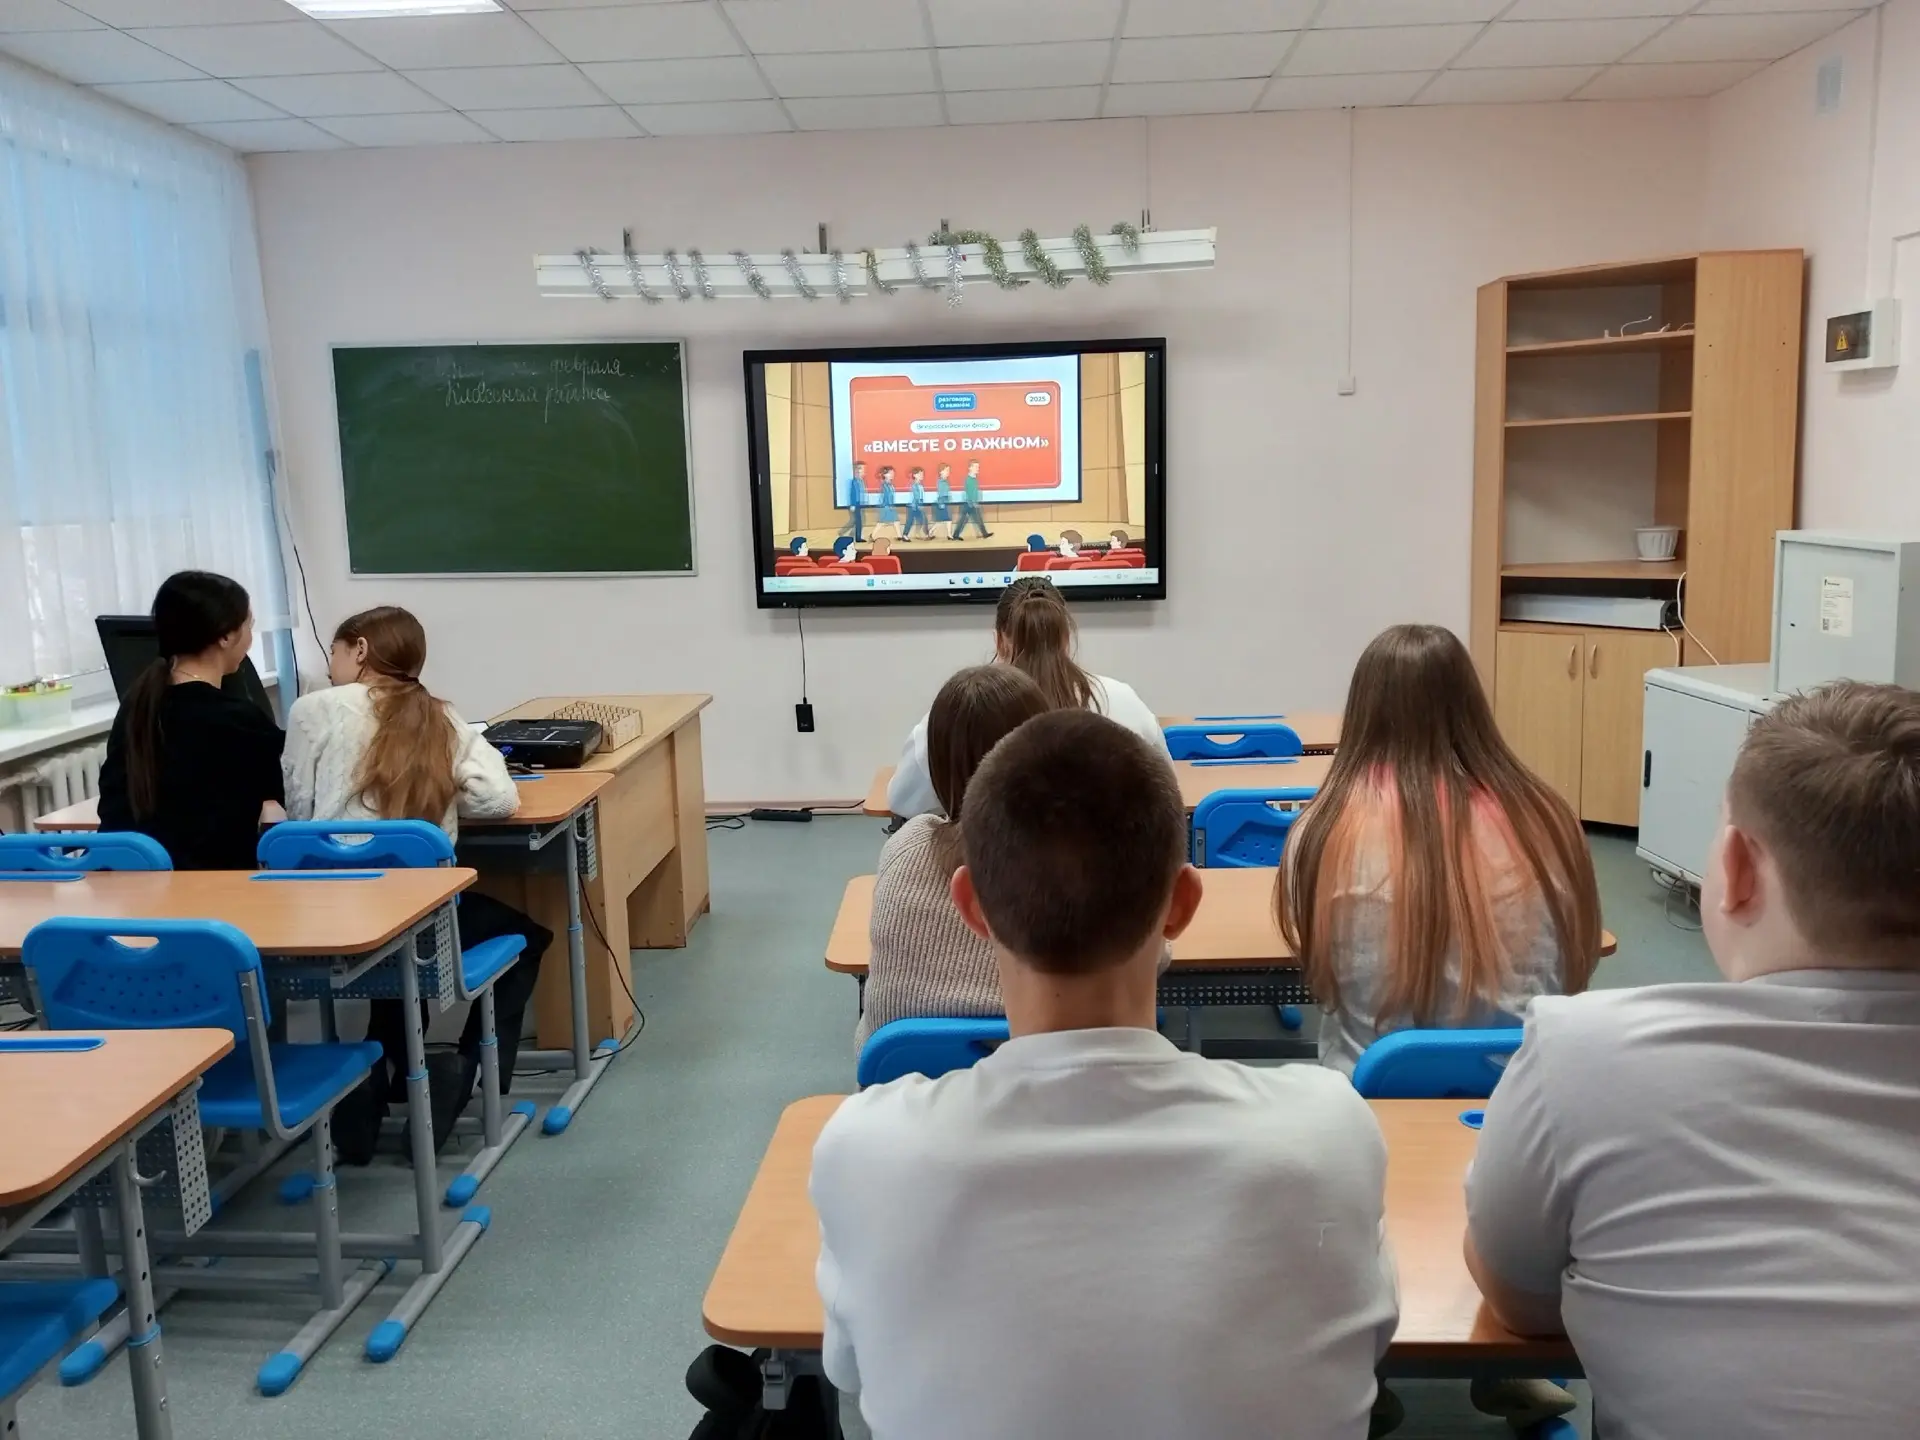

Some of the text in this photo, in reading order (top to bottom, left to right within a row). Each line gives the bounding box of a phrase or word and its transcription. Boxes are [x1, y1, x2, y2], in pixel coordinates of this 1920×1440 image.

[863, 436, 1050, 453] «ВМЕСТЕ О ВАЖНОМ»
